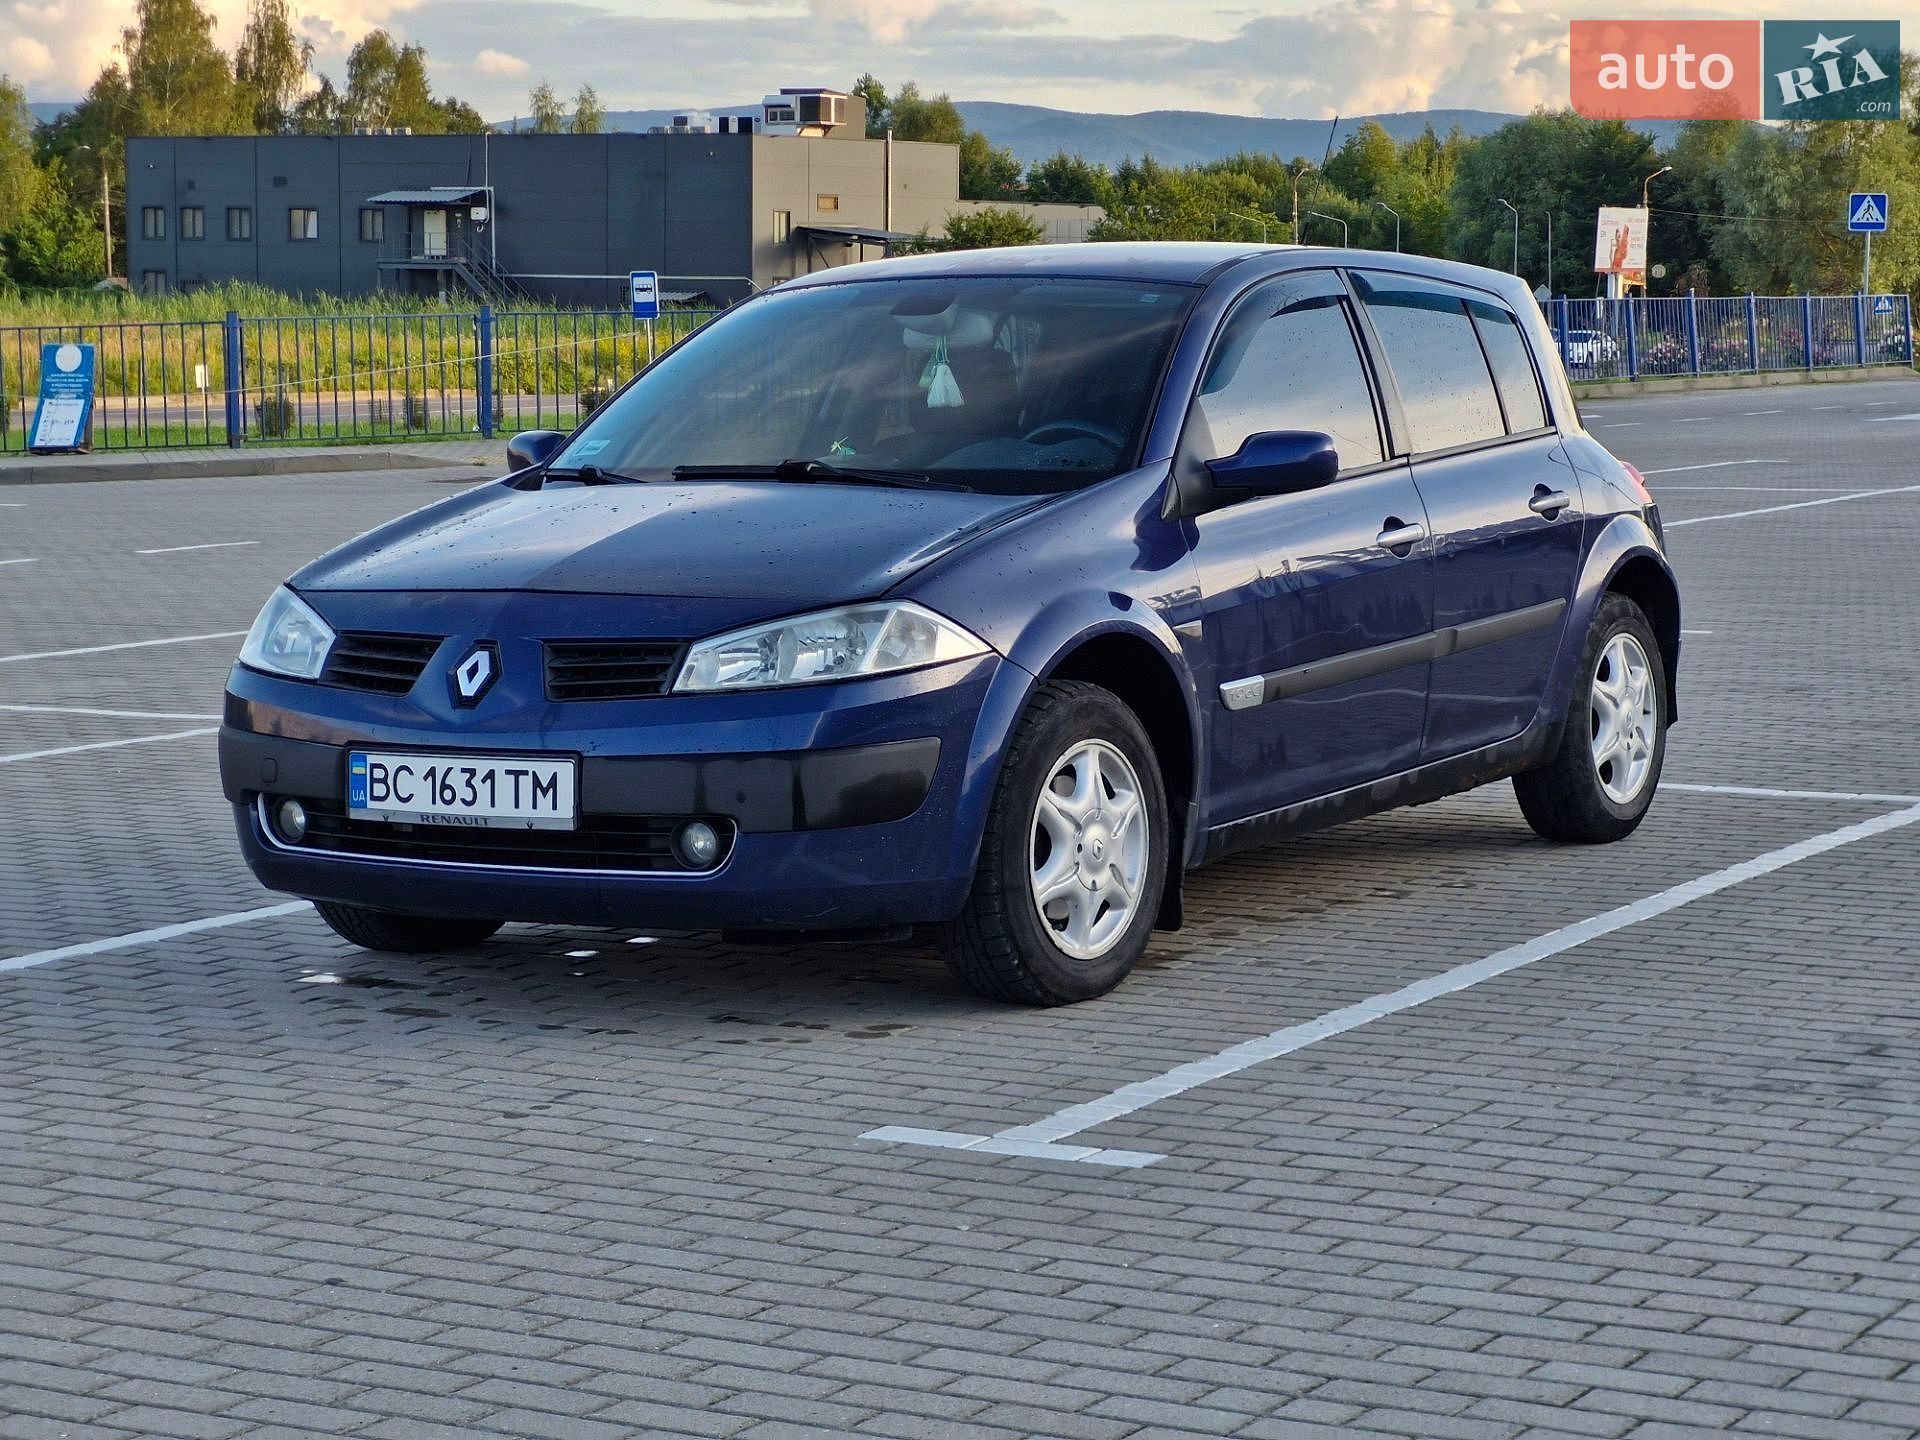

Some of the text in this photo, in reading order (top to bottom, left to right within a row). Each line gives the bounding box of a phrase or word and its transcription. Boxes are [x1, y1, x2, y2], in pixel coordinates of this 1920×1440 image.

[369, 762, 559, 811] BC 1631 TM
[352, 789, 366, 802] UA
[420, 814, 490, 827] RENAULT
